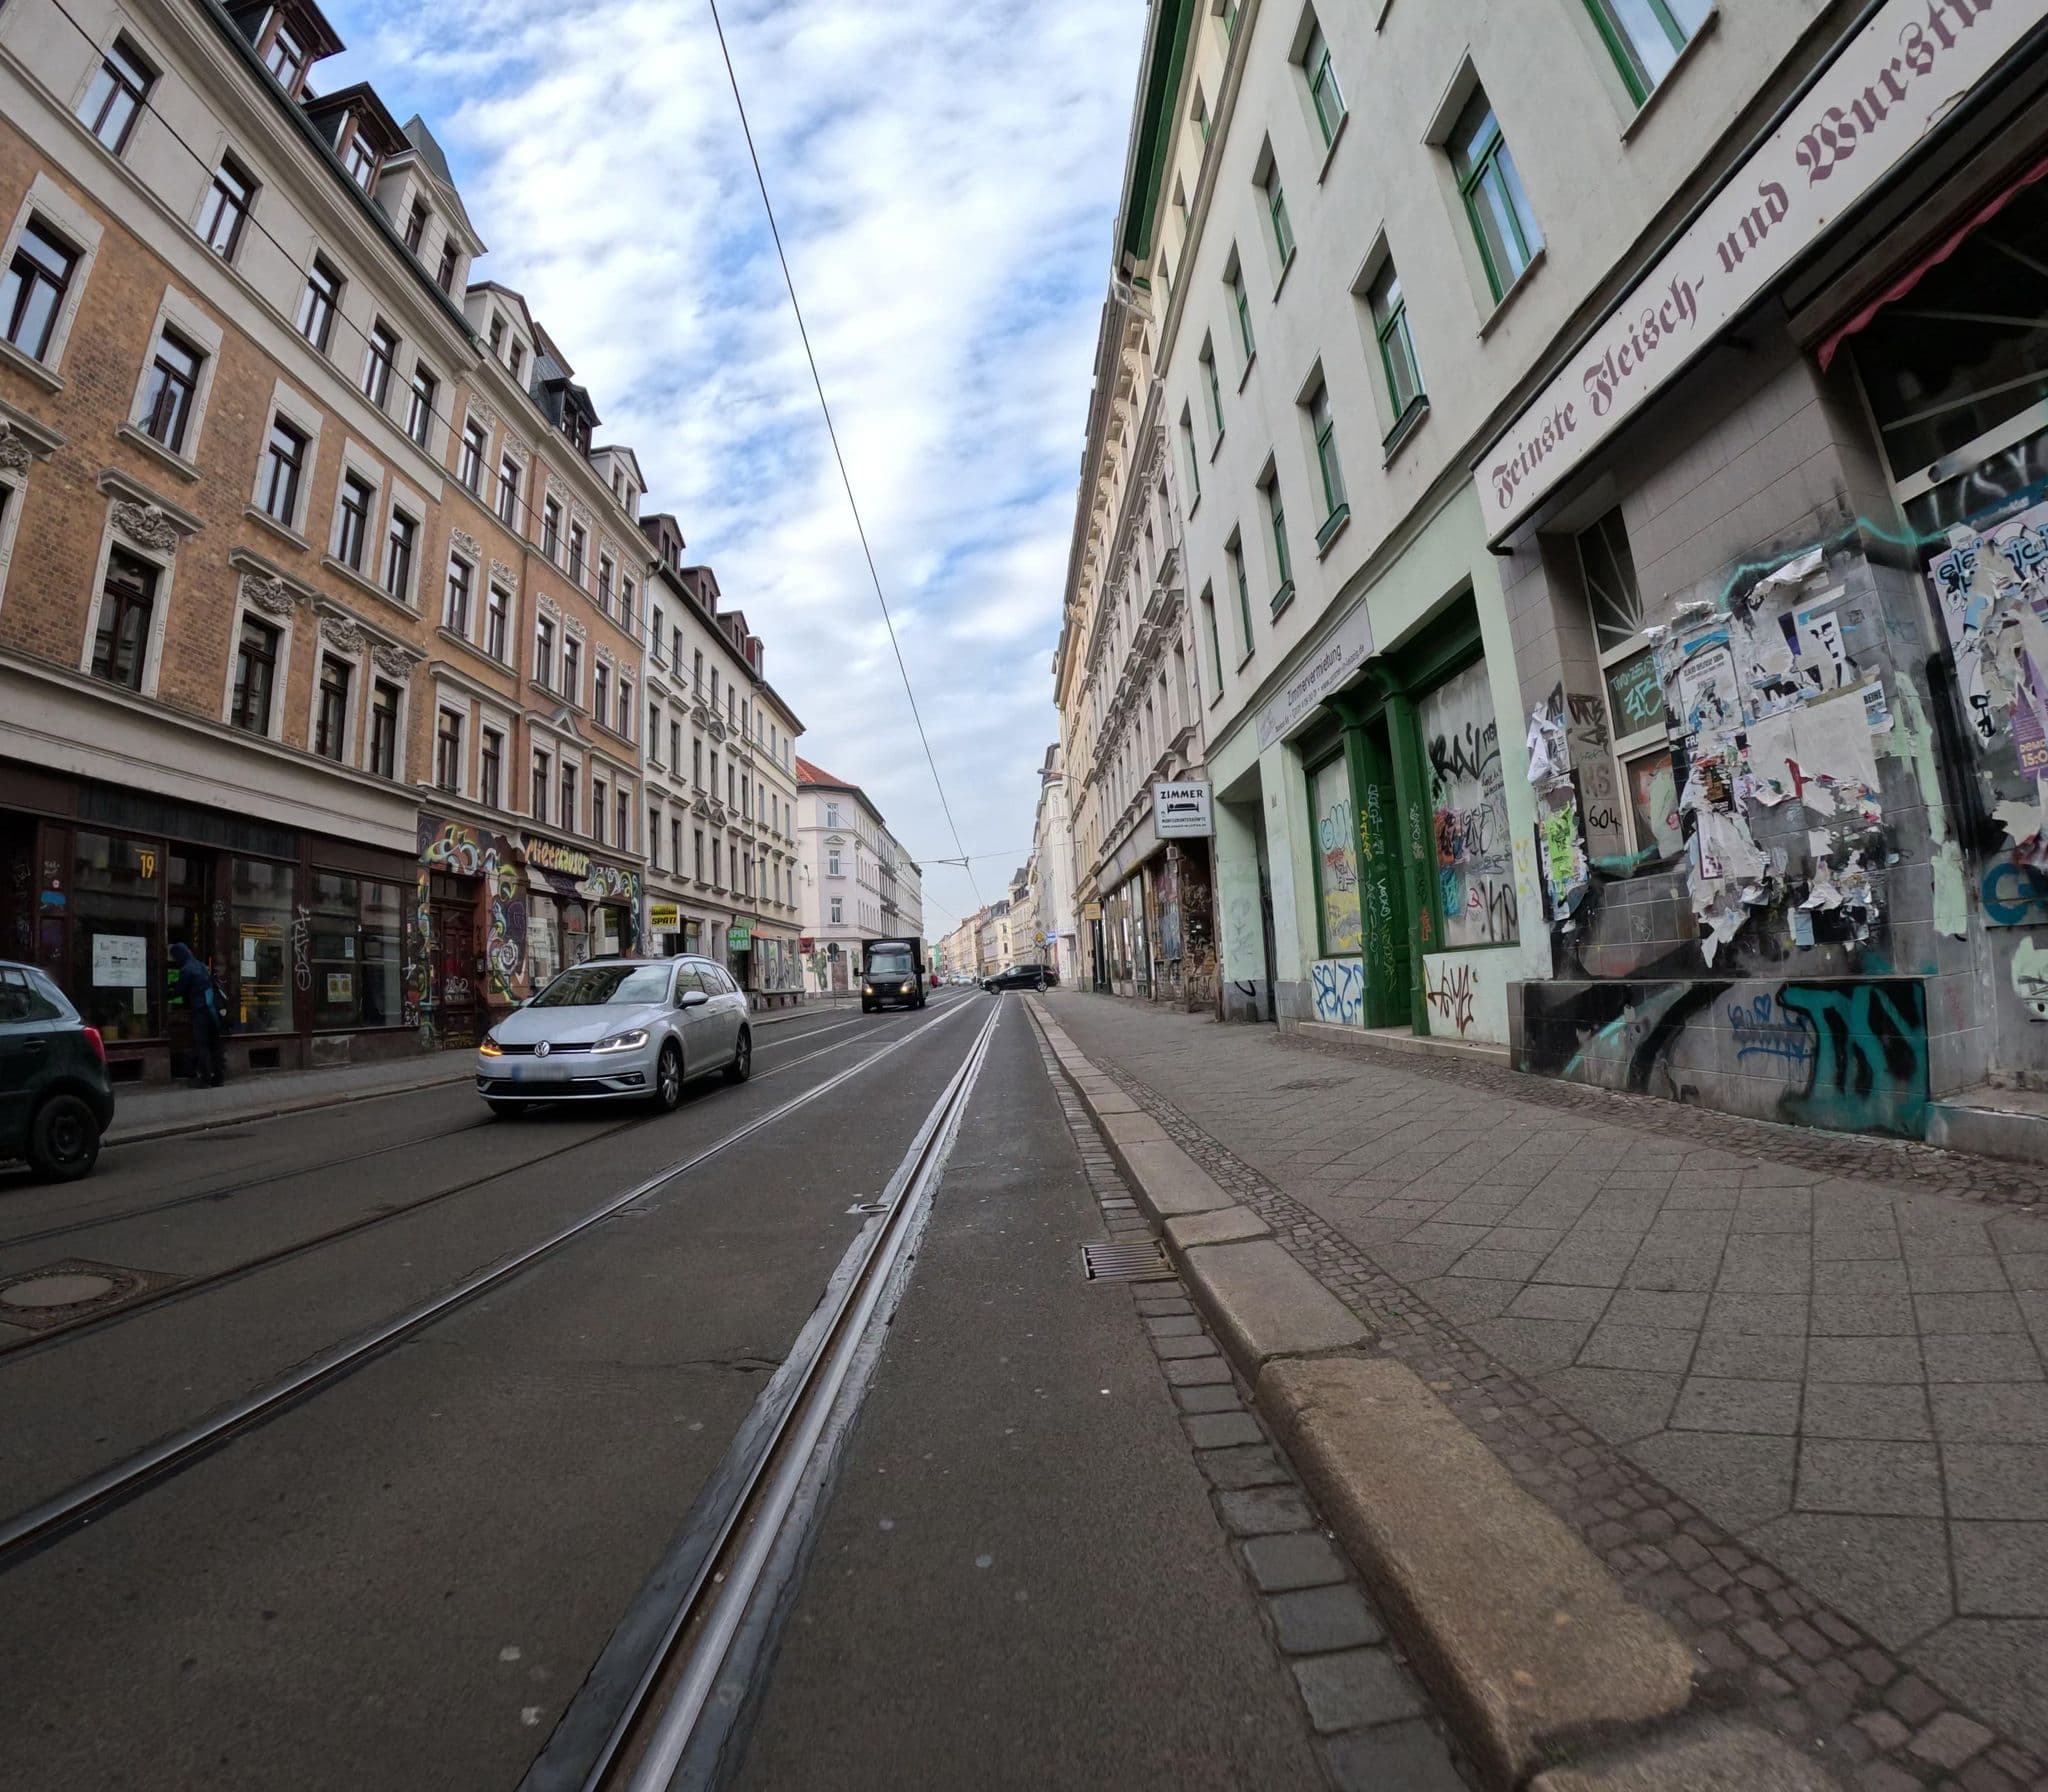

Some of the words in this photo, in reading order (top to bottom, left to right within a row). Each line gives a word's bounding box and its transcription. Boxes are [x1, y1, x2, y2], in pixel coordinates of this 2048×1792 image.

[1492, 401, 1577, 510] Feinste
[1582, 273, 1705, 417] Fleisch-
[1715, 180, 1790, 274] und
[1286, 643, 1343, 707] Zimmervermietung
[1160, 789, 1204, 800] ZIMMER
[1588, 805, 1621, 832] 604
[140, 854, 155, 879] 19
[728, 929, 748, 938] SPIEL
